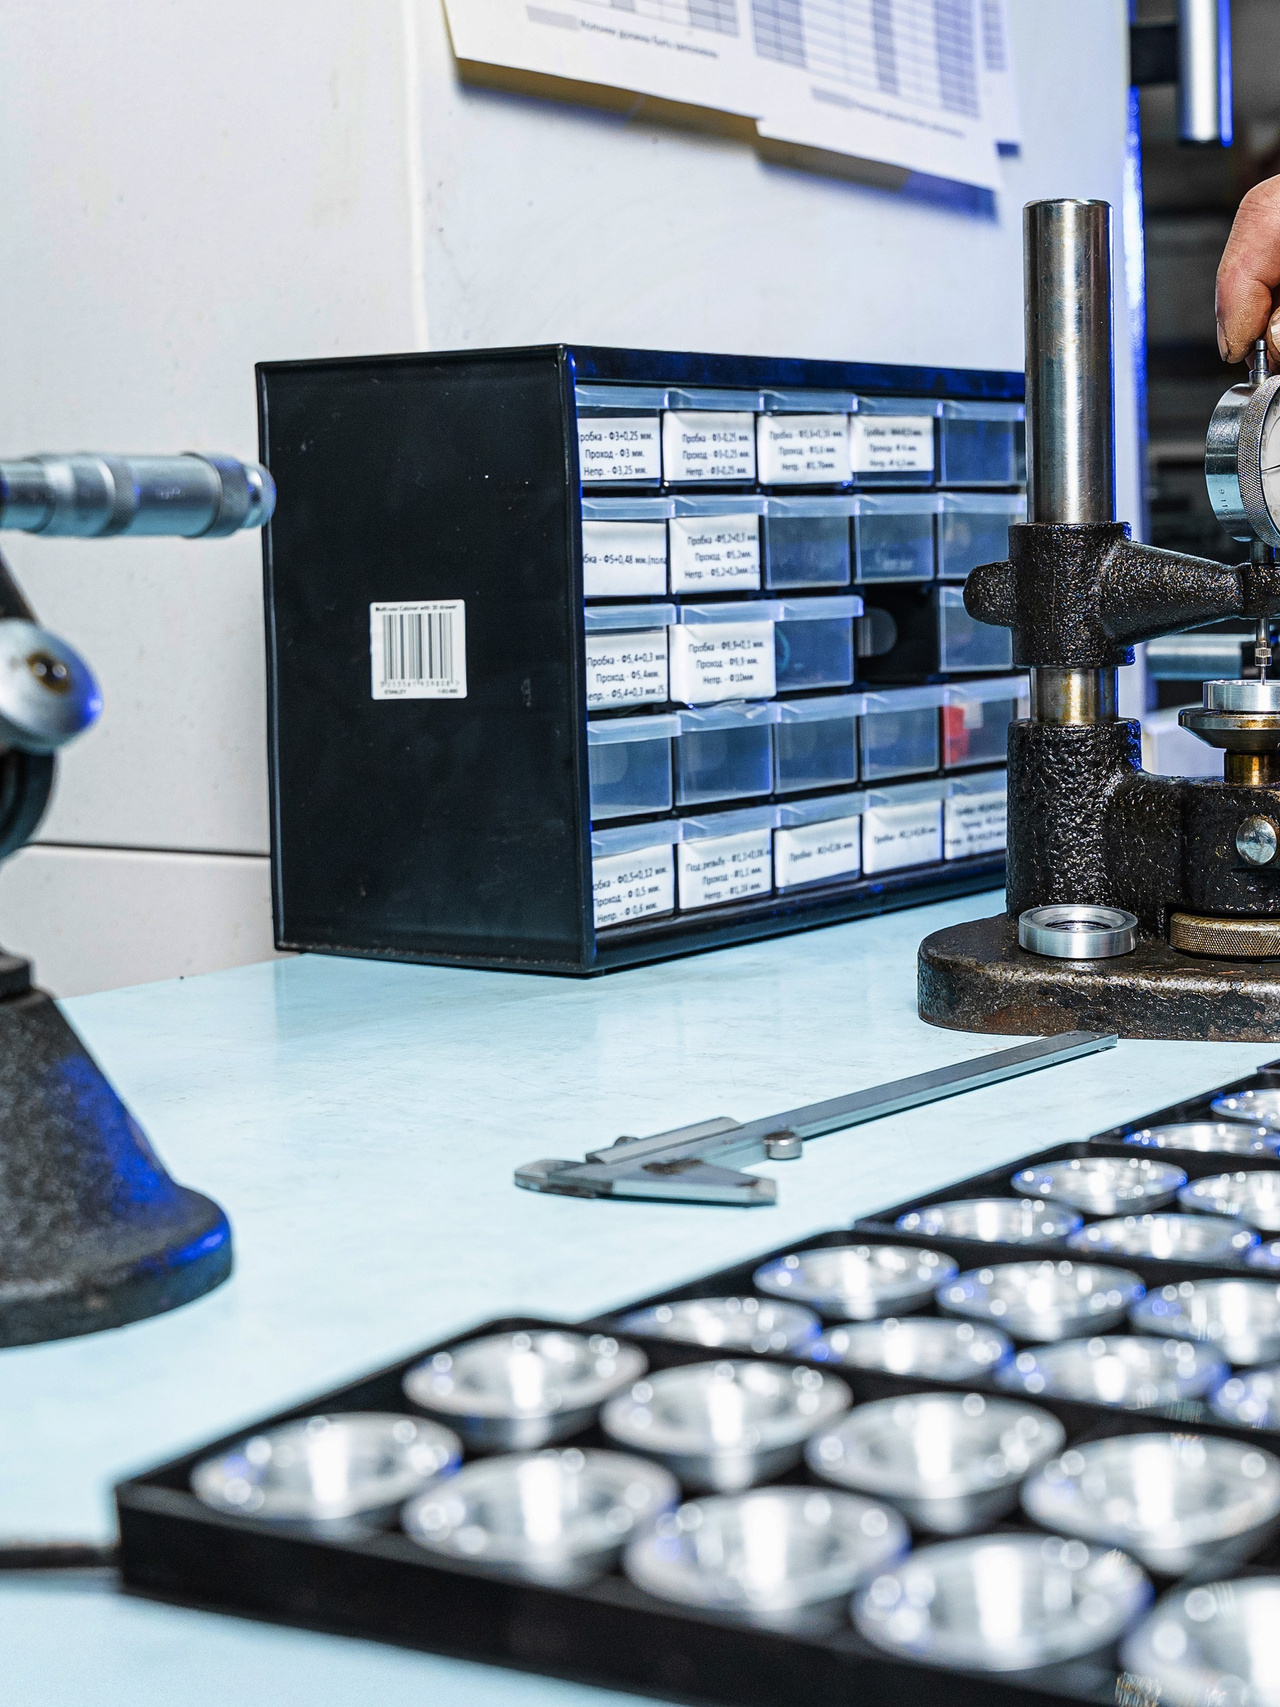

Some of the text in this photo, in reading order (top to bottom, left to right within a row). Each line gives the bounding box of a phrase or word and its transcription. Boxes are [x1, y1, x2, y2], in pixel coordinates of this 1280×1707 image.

[580, 431, 602, 443] робка
[682, 433, 706, 443] Пробка
[585, 449, 613, 459] Проход
[682, 450, 707, 460] Проход
[584, 467, 605, 477] Непр.
[612, 466, 633, 475] Ф3,25
[688, 535, 712, 546] Пробка
[695, 552, 720, 562] Проход
[688, 642, 715, 653] Пробка
[587, 656, 614, 668] Пробка
[696, 659, 723, 669] Проход
[596, 673, 625, 683] Проход
[588, 692, 604, 702] епр.
[593, 879, 611, 891] обка
[702, 875, 728, 885] Проход
[597, 913, 617, 923] Непр.
